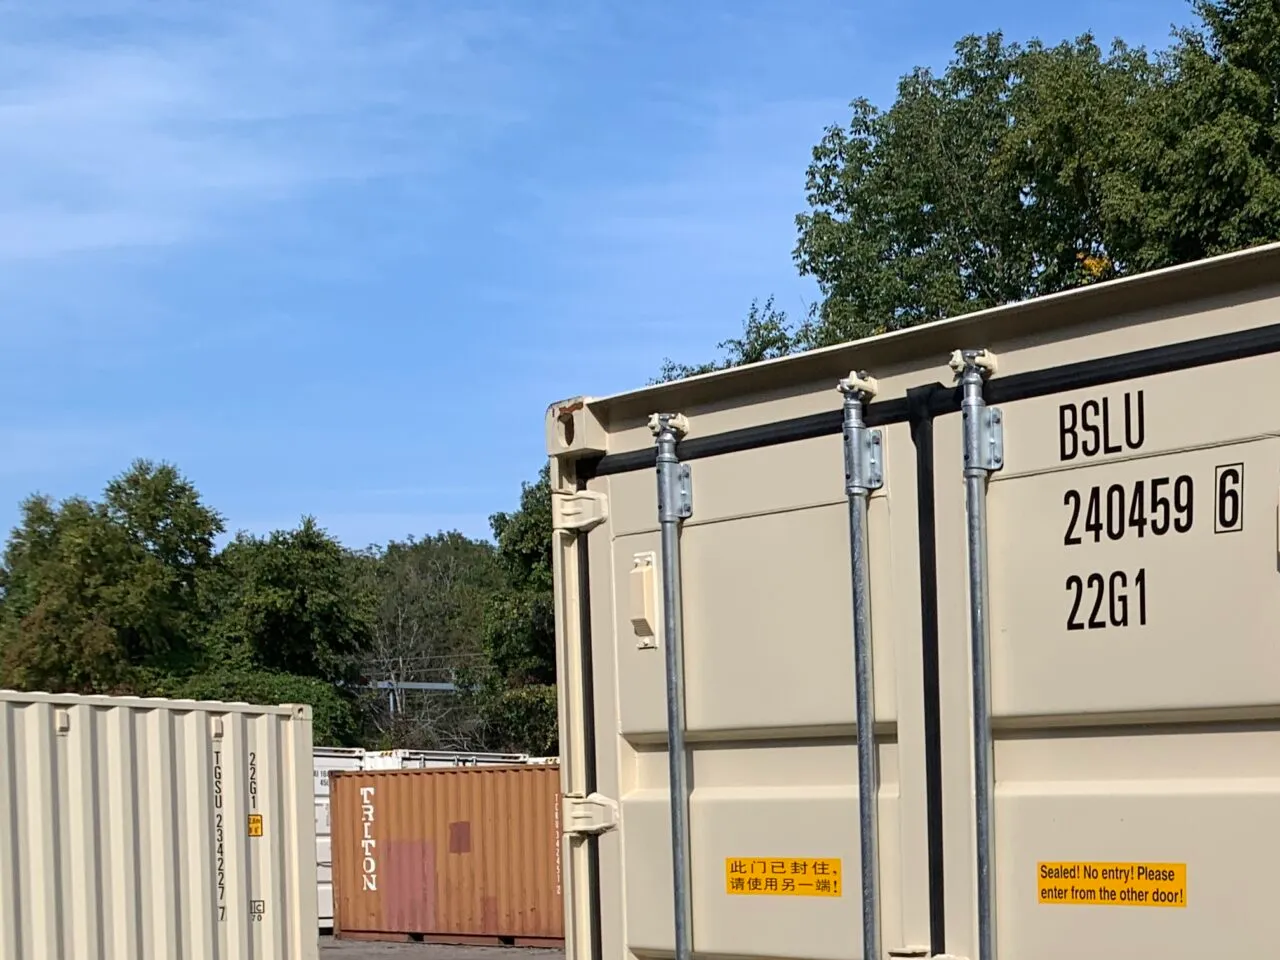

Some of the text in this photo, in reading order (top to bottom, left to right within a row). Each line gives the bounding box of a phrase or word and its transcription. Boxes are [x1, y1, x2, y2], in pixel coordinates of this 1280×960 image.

[1059, 390, 1145, 461] BSLU
[1064, 468, 1240, 546] 240459 6
[1066, 568, 1147, 631] 22G1
[249, 752, 257, 809] 22G1
[213, 751, 226, 921] TGSU 234227 7
[360, 787, 377, 891] TRITON
[1040, 865, 1175, 884] Sealed! No entry! Please
[1041, 886, 1184, 904] enter from the other door!
